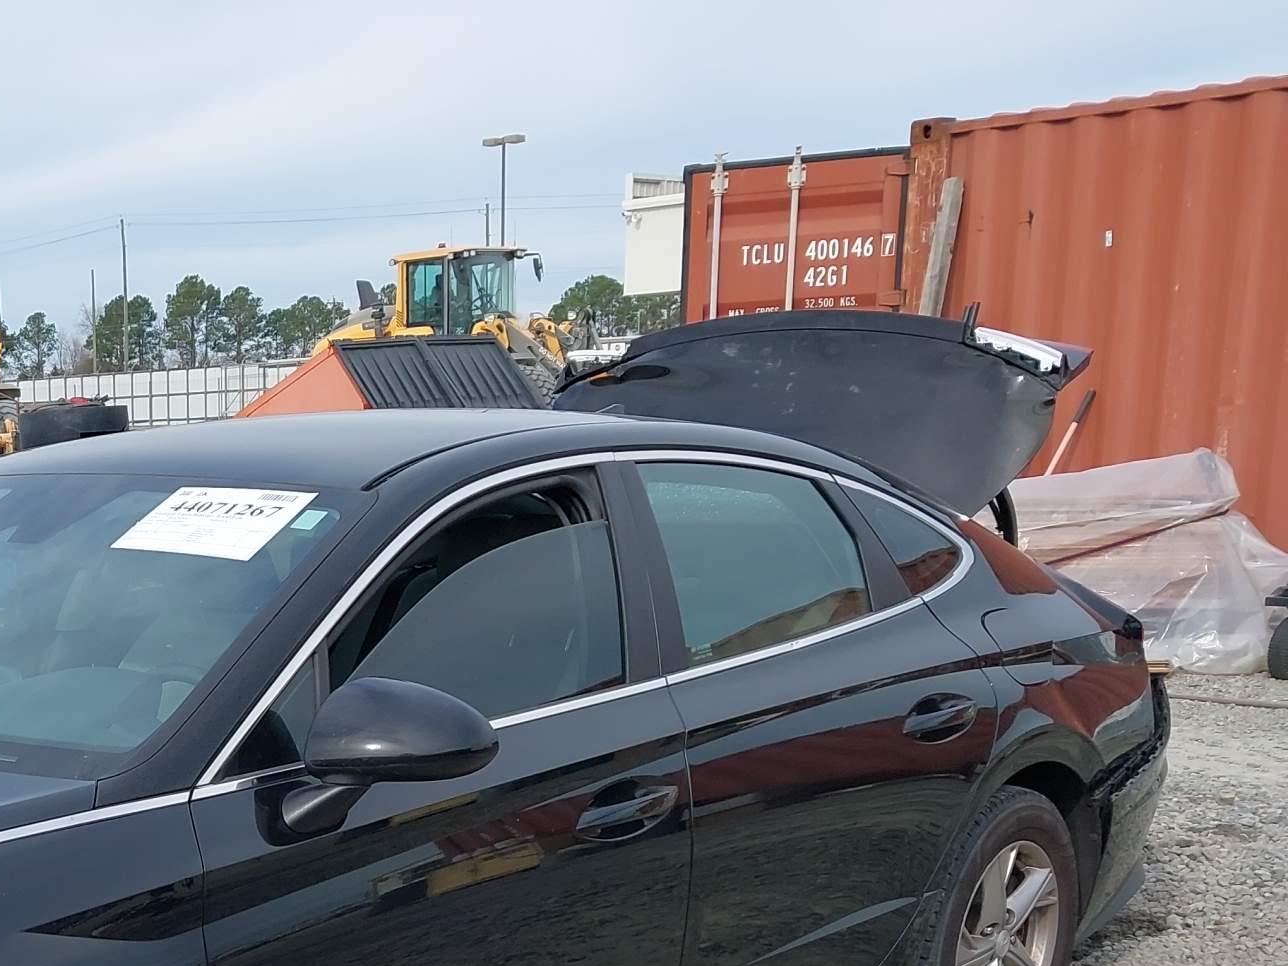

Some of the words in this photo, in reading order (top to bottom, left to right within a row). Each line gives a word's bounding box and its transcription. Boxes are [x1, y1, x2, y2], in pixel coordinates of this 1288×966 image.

[741, 243, 785, 266] TCLU
[805, 236, 874, 261] 400146
[883, 234, 895, 255] 7
[804, 265, 848, 287] 42G1
[804, 297, 834, 308] 32.500
[840, 296, 859, 307] KGS.
[170, 501, 285, 518] 44071267
